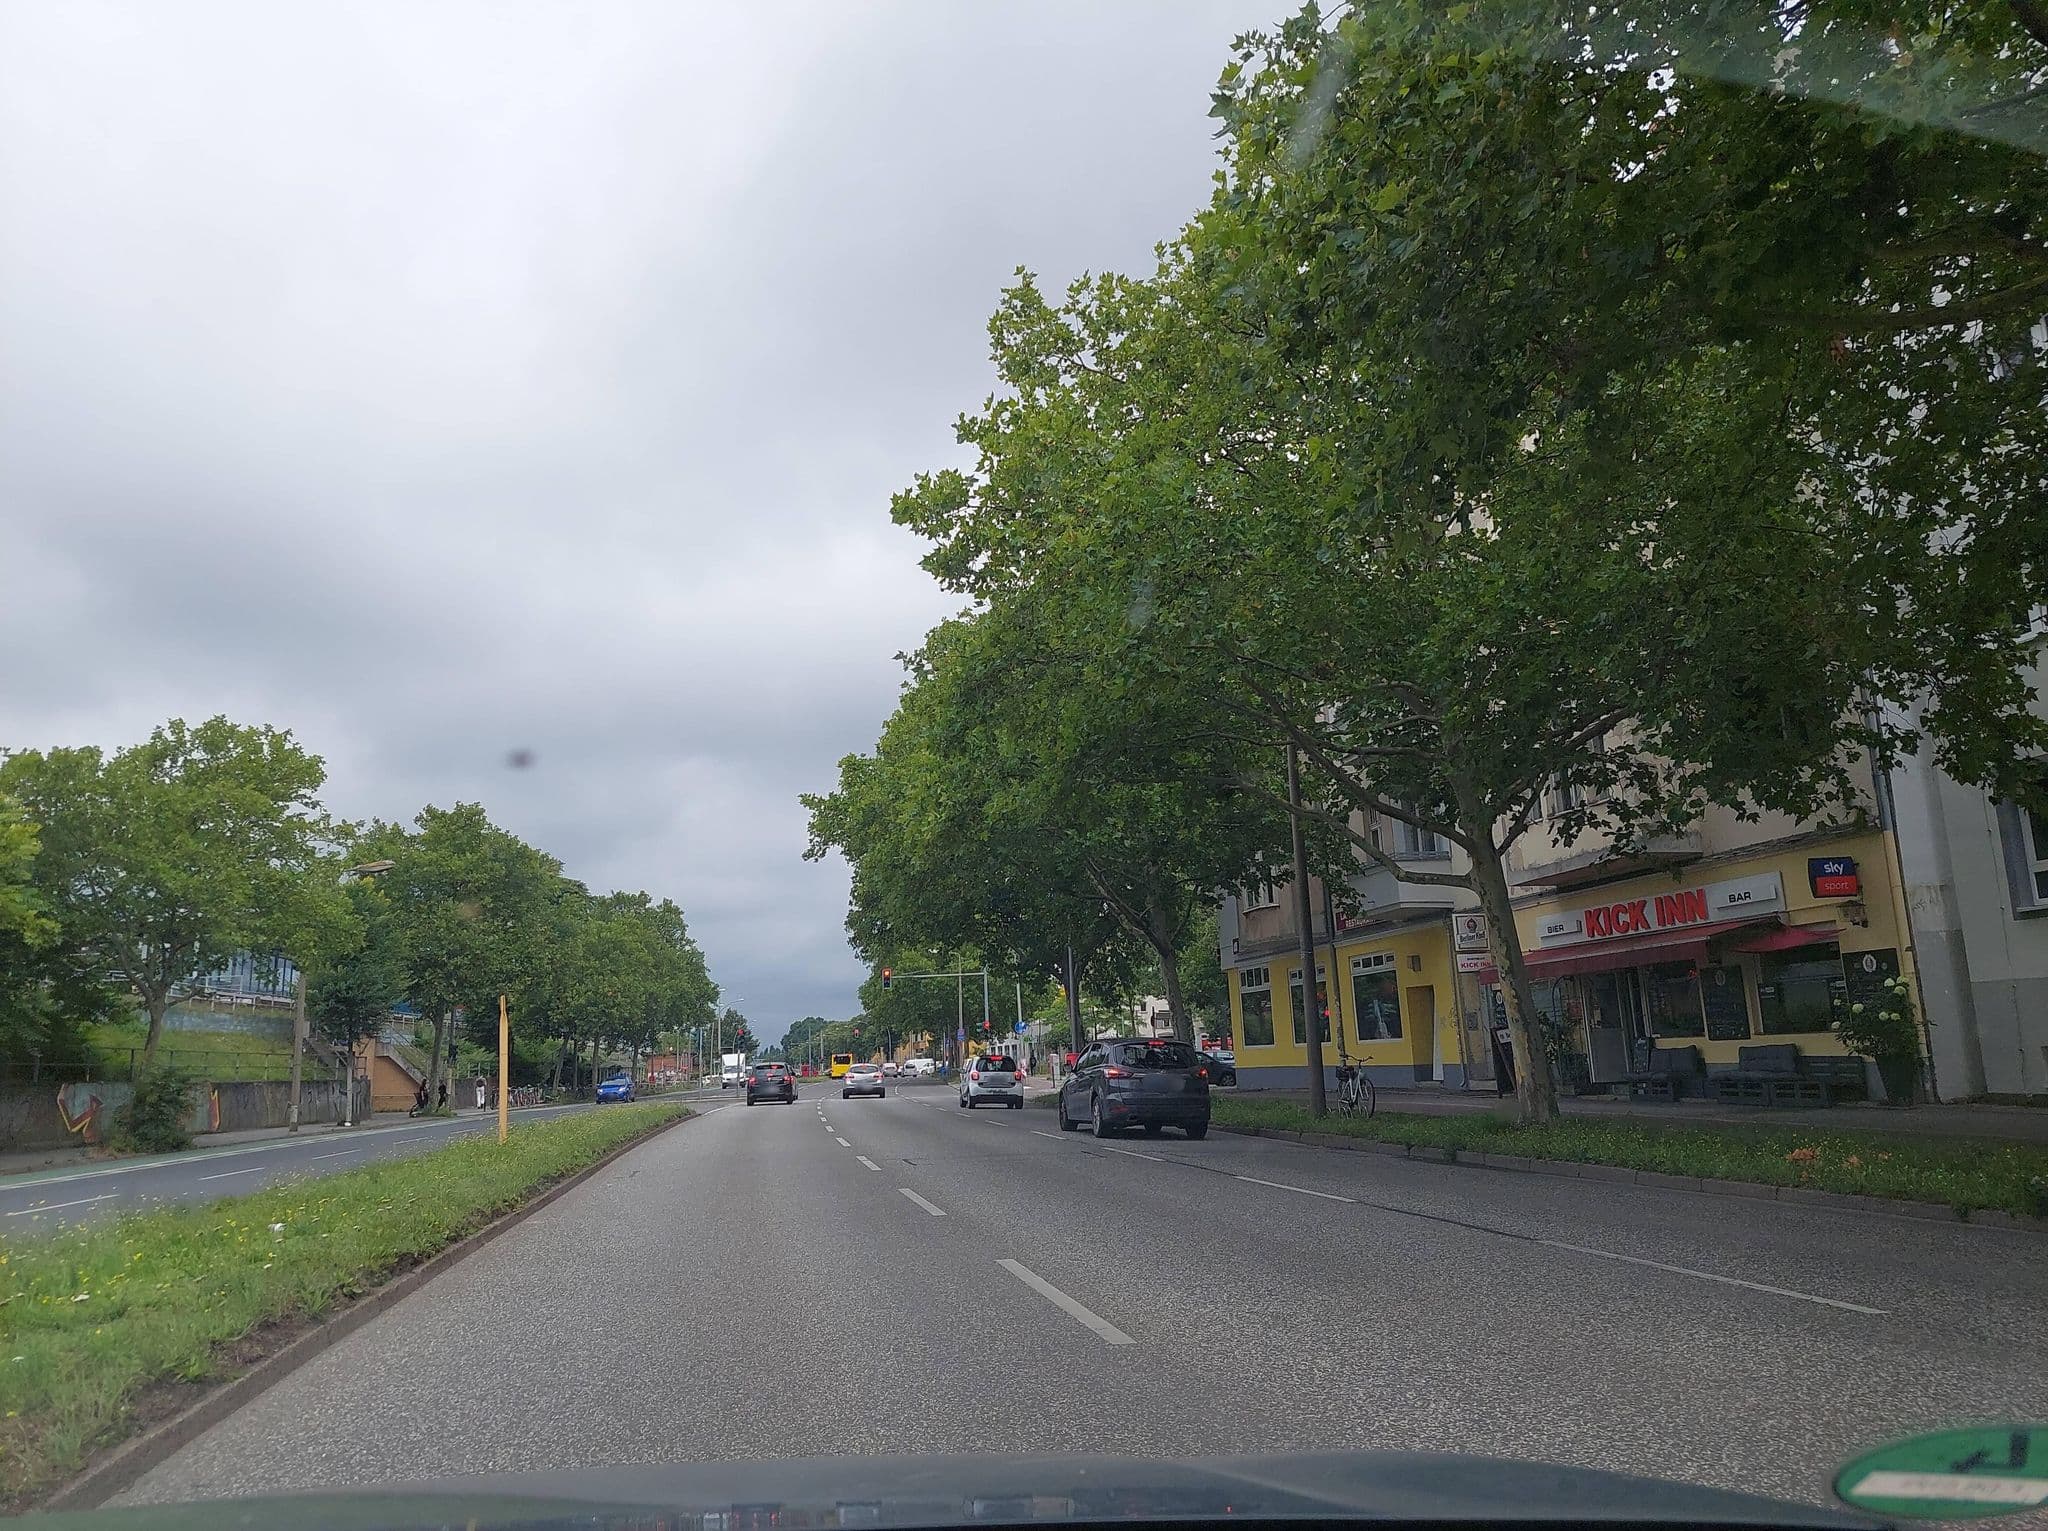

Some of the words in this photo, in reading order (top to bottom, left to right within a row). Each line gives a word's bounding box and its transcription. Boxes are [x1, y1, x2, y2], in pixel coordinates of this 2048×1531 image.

[1823, 861, 1844, 875] sky
[1824, 881, 1849, 893] sport
[1728, 891, 1752, 903] BAR
[1584, 900, 1650, 938] KICK
[1654, 889, 1709, 927] INN
[1547, 924, 1565, 934] BIER
